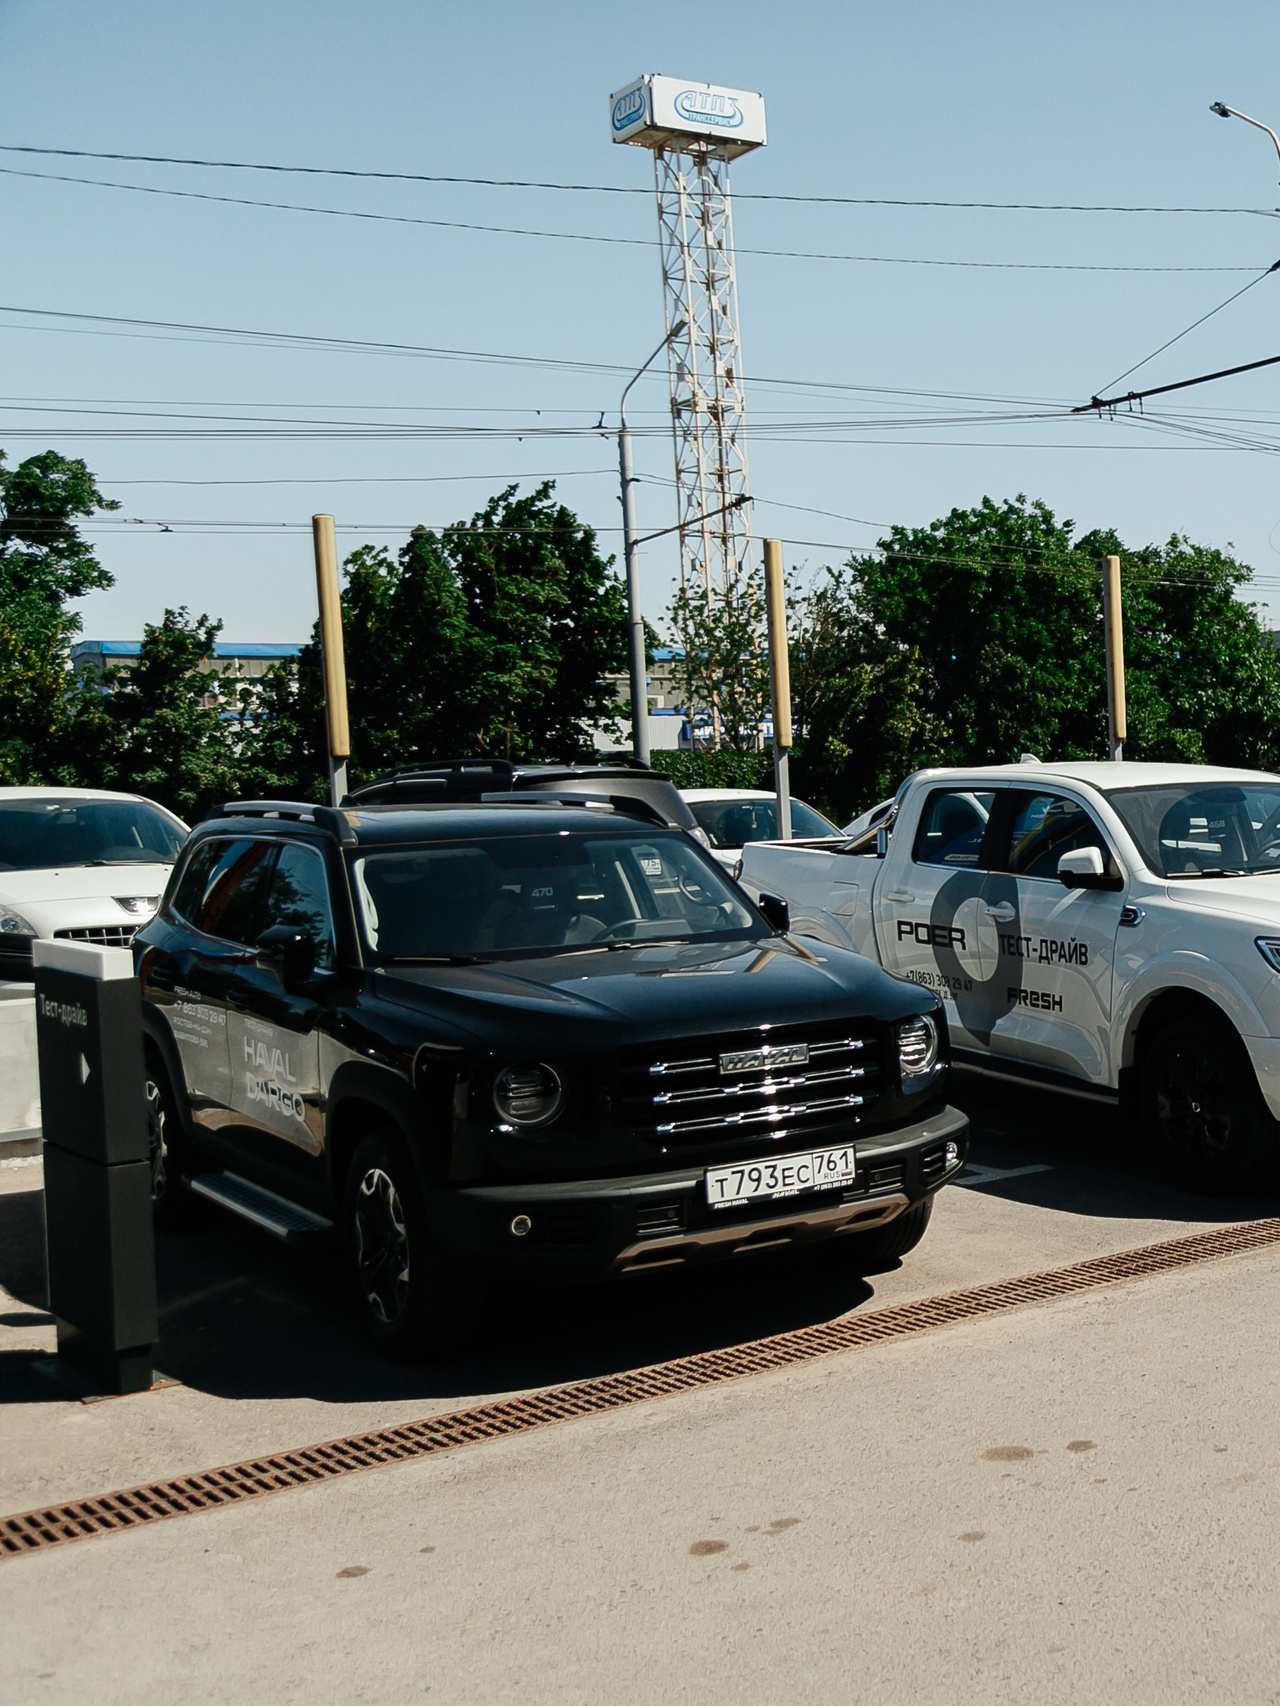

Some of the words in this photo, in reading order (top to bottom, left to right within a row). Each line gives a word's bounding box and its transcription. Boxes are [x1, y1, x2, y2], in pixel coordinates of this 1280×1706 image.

[531, 887, 554, 897] 470
[896, 919, 967, 951] POER
[1000, 933, 1089, 966] ТЕСТ-ДРАЙВ
[39, 993, 88, 1027] Тест-драйв
[243, 1035, 297, 1083] HAVAL
[727, 1047, 805, 1070] HAVAL
[246, 1071, 306, 1122] DARGO
[814, 1150, 849, 1175] 761
[823, 1170, 841, 1180] RUS
[771, 1189, 801, 1199] HAVAL
